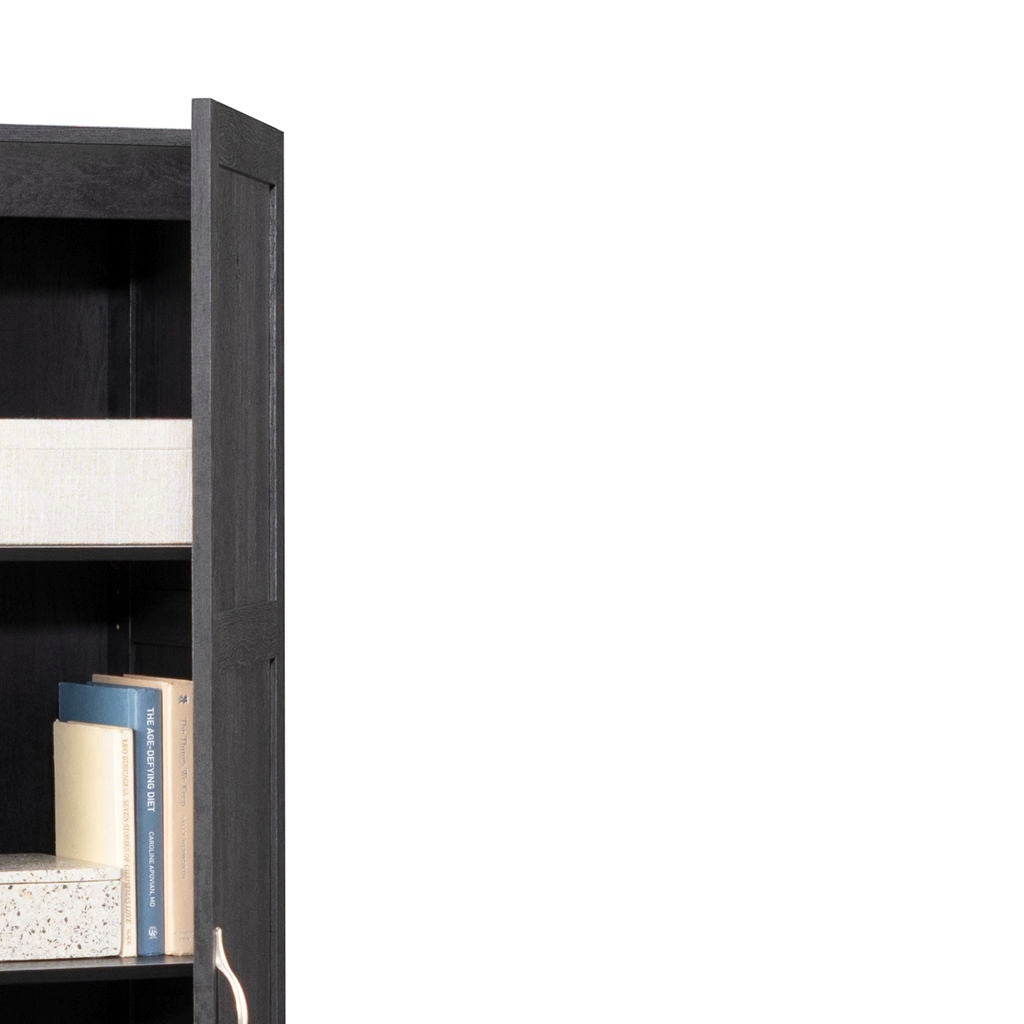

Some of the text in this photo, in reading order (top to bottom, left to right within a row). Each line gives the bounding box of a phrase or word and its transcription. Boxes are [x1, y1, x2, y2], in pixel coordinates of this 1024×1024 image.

[146, 707, 156, 812] THE AGE-DEFYING DIET
[148, 865, 156, 895] APOVIAN,
[149, 896, 156, 908] MD
